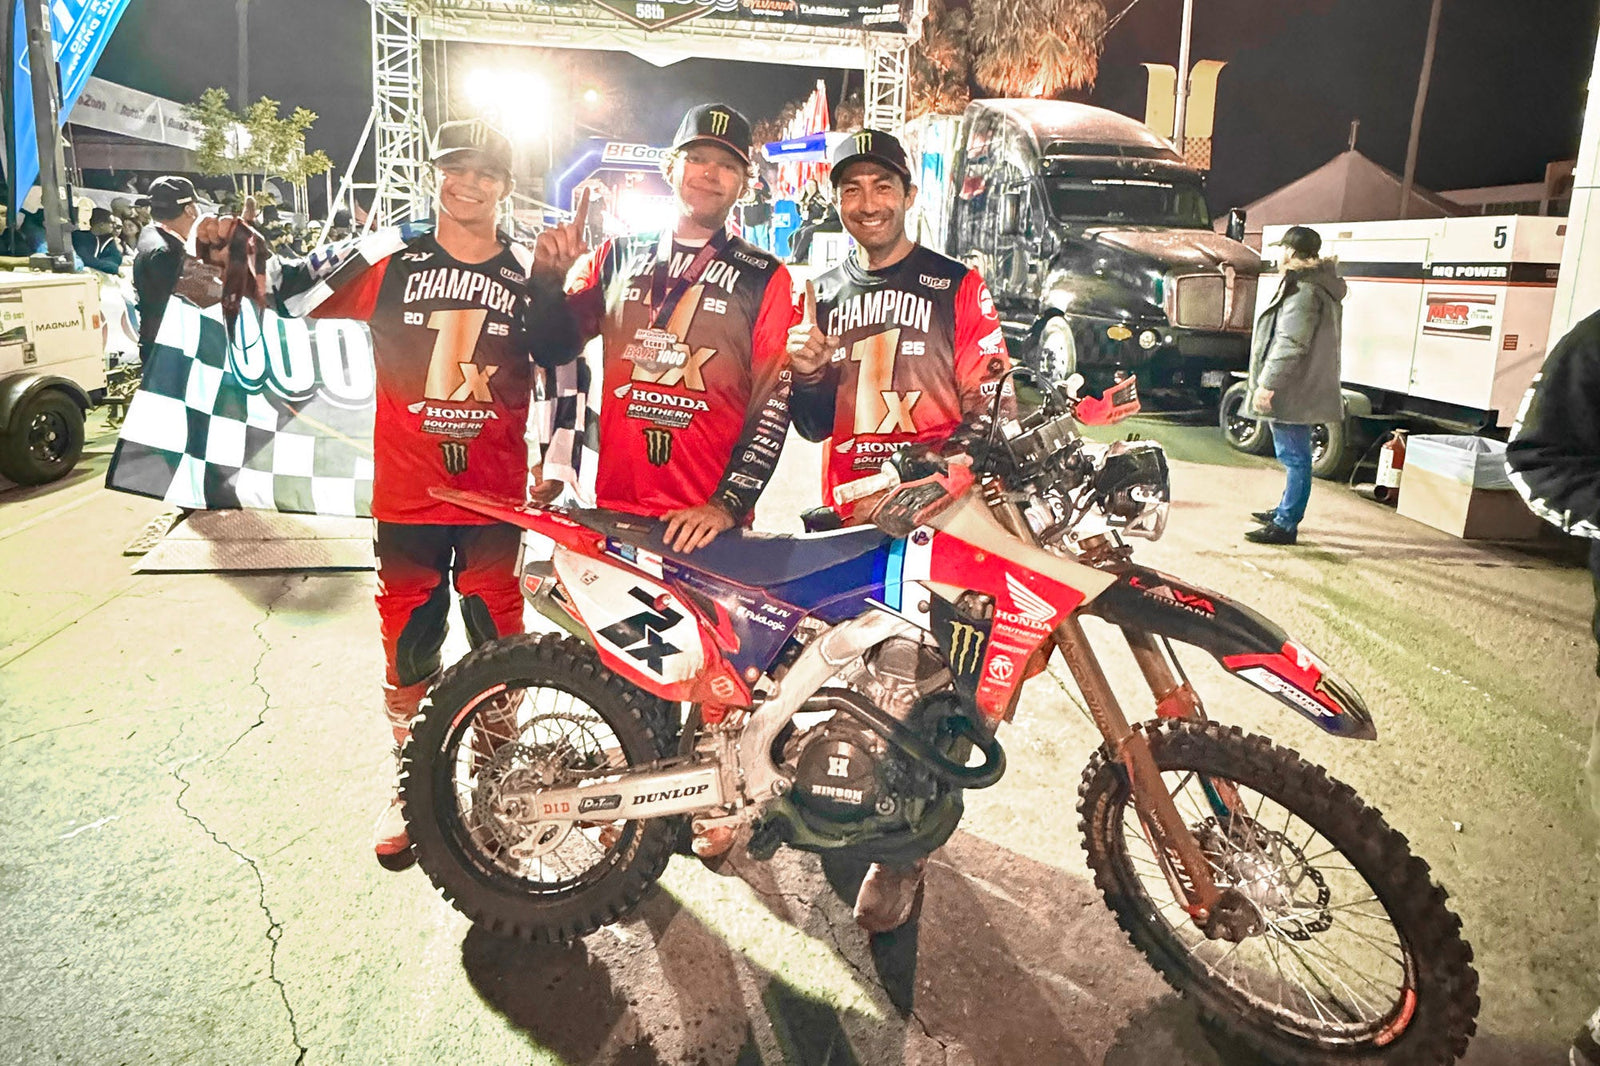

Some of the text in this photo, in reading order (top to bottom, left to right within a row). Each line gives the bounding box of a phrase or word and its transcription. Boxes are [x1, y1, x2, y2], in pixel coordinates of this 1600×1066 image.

[635, 3, 665, 19] 58th
[1493, 225, 1508, 249] 5
[400, 252, 434, 262] FLY
[1431, 265, 1508, 278] MQ POWER
[403, 267, 516, 319] CHAMPION
[702, 297, 728, 315] 25
[827, 289, 933, 337] CHAMPION
[1426, 304, 1470, 323] MRR
[35, 319, 80, 332] MAGNUM
[403, 311, 424, 325] 20
[487, 322, 510, 336] 25
[901, 341, 925, 355] 25
[655, 349, 687, 366] 1000
[632, 389, 710, 411] HONDA
[426, 406, 499, 420] HONDA
[627, 403, 694, 420] SOUTHERN
[423, 419, 484, 430] SOUTHERN
[1143, 590, 1216, 620] PROPANE
[747, 610, 788, 632] FluidLogic
[995, 608, 1053, 633] HONDA
[995, 623, 1045, 640] SOUTHERN
[631, 784, 710, 806] DUNLOP
